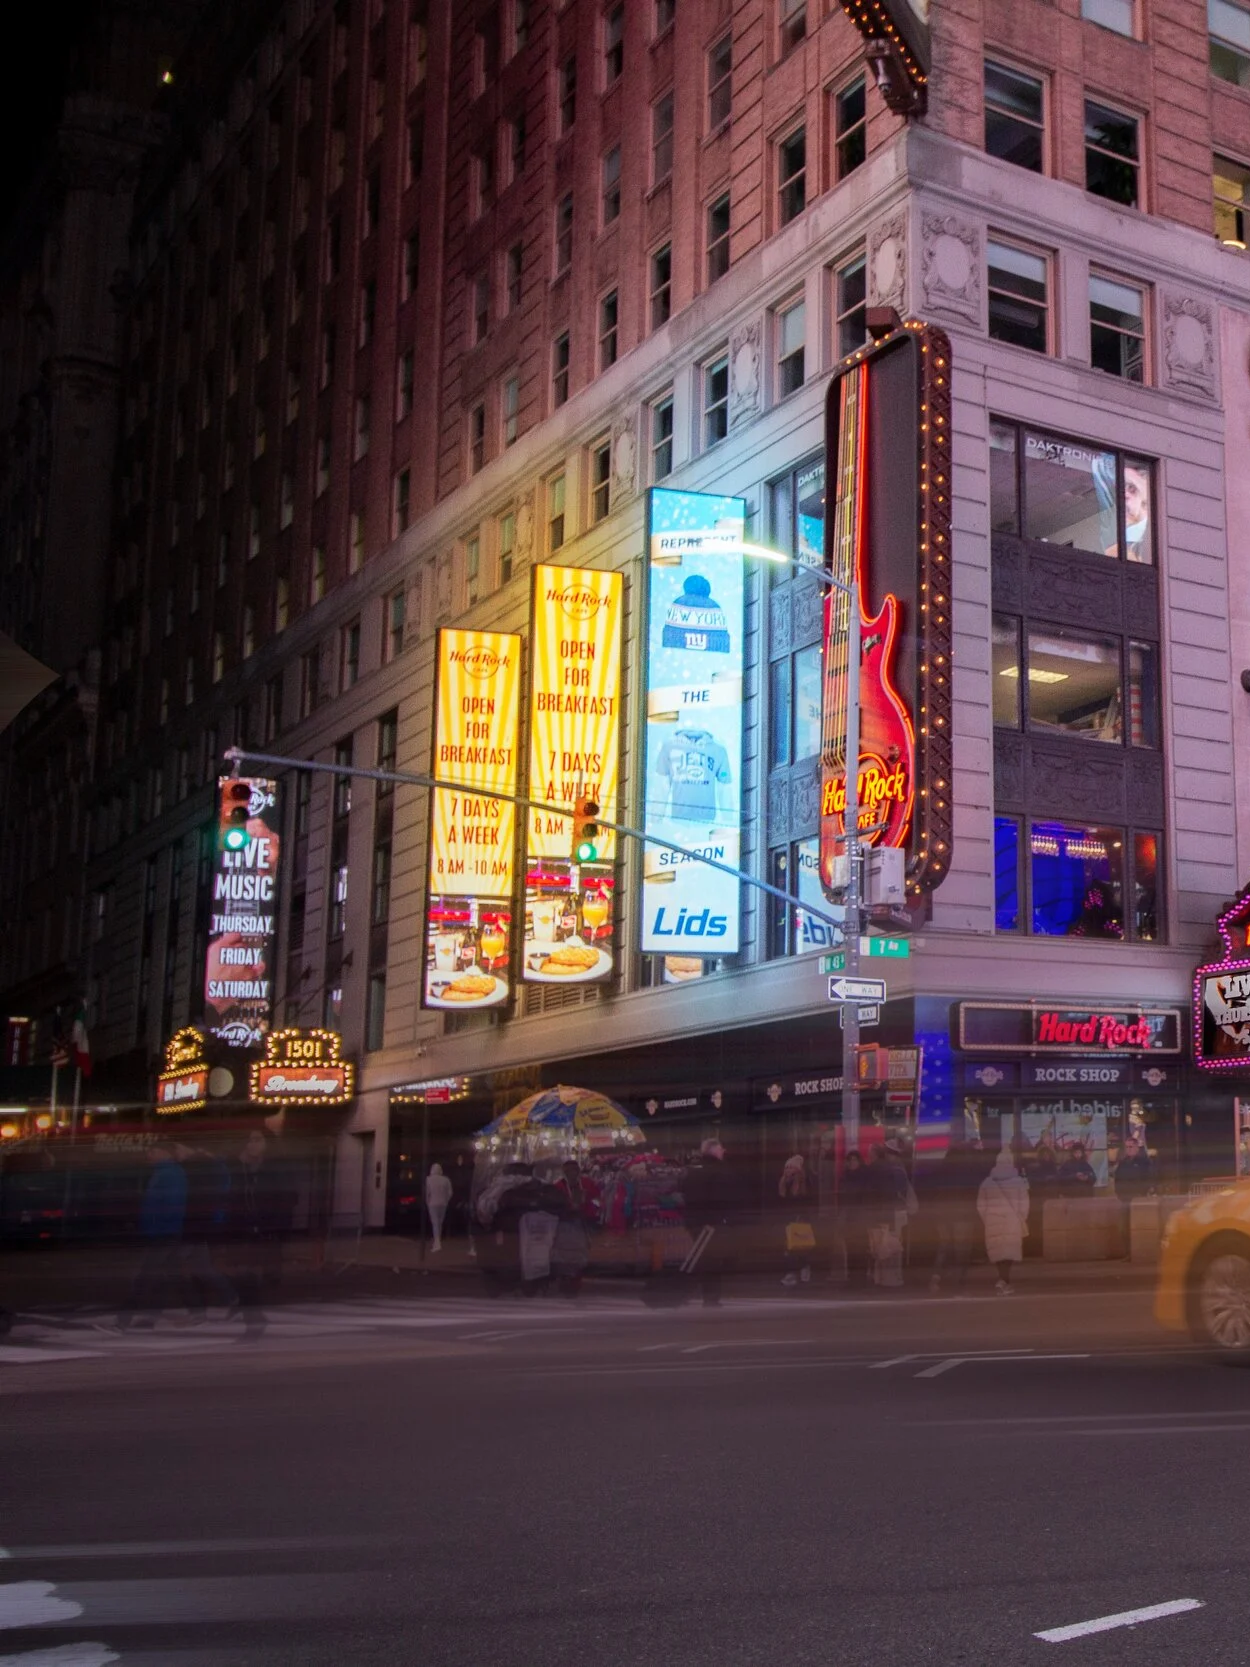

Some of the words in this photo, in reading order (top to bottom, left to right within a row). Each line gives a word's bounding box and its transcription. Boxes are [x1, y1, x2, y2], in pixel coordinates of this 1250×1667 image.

[546, 589, 581, 605] Hard
[580, 592, 612, 608] Rock
[450, 650, 481, 666] Hard
[480, 651, 511, 668] Rock
[560, 640, 596, 660] OPEN
[564, 667, 590, 687] FOR
[537, 693, 615, 717] BREAKFAST
[681, 689, 710, 703] THE
[462, 696, 495, 716] OPEN
[465, 720, 490, 739] FOR
[440, 745, 512, 766] BREAKFAST
[549, 751, 556, 771] 7
[562, 751, 601, 773] DAYS
[546, 780, 555, 801] A
[822, 773, 863, 816] Ha
[864, 763, 906, 809] Rock
[451, 799, 459, 817] 7
[463, 798, 500, 818] DAYS
[535, 818, 542, 834] 8
[546, 818, 564, 835] AM
[857, 812, 876, 830] AFE
[448, 825, 458, 845] A
[462, 825, 500, 846] WEEK
[437, 859, 444, 874] 8
[449, 859, 466, 875] AM
[490, 859, 508, 876] AM
[214, 873, 273, 901] MUSIC
[652, 907, 727, 937] Lids
[219, 947, 261, 966] FRIDAY
[879, 940, 886, 954] 7
[208, 980, 269, 999] SATURDAY
[862, 985, 878, 994] WAY
[1039, 1012, 1098, 1044] Hard
[1098, 1015, 1151, 1050] Rock
[285, 1040, 321, 1058] 1501
[1035, 1068, 1077, 1082] ROCK
[1079, 1068, 1121, 1082] SHOP
[794, 1080, 820, 1095] ROCK
